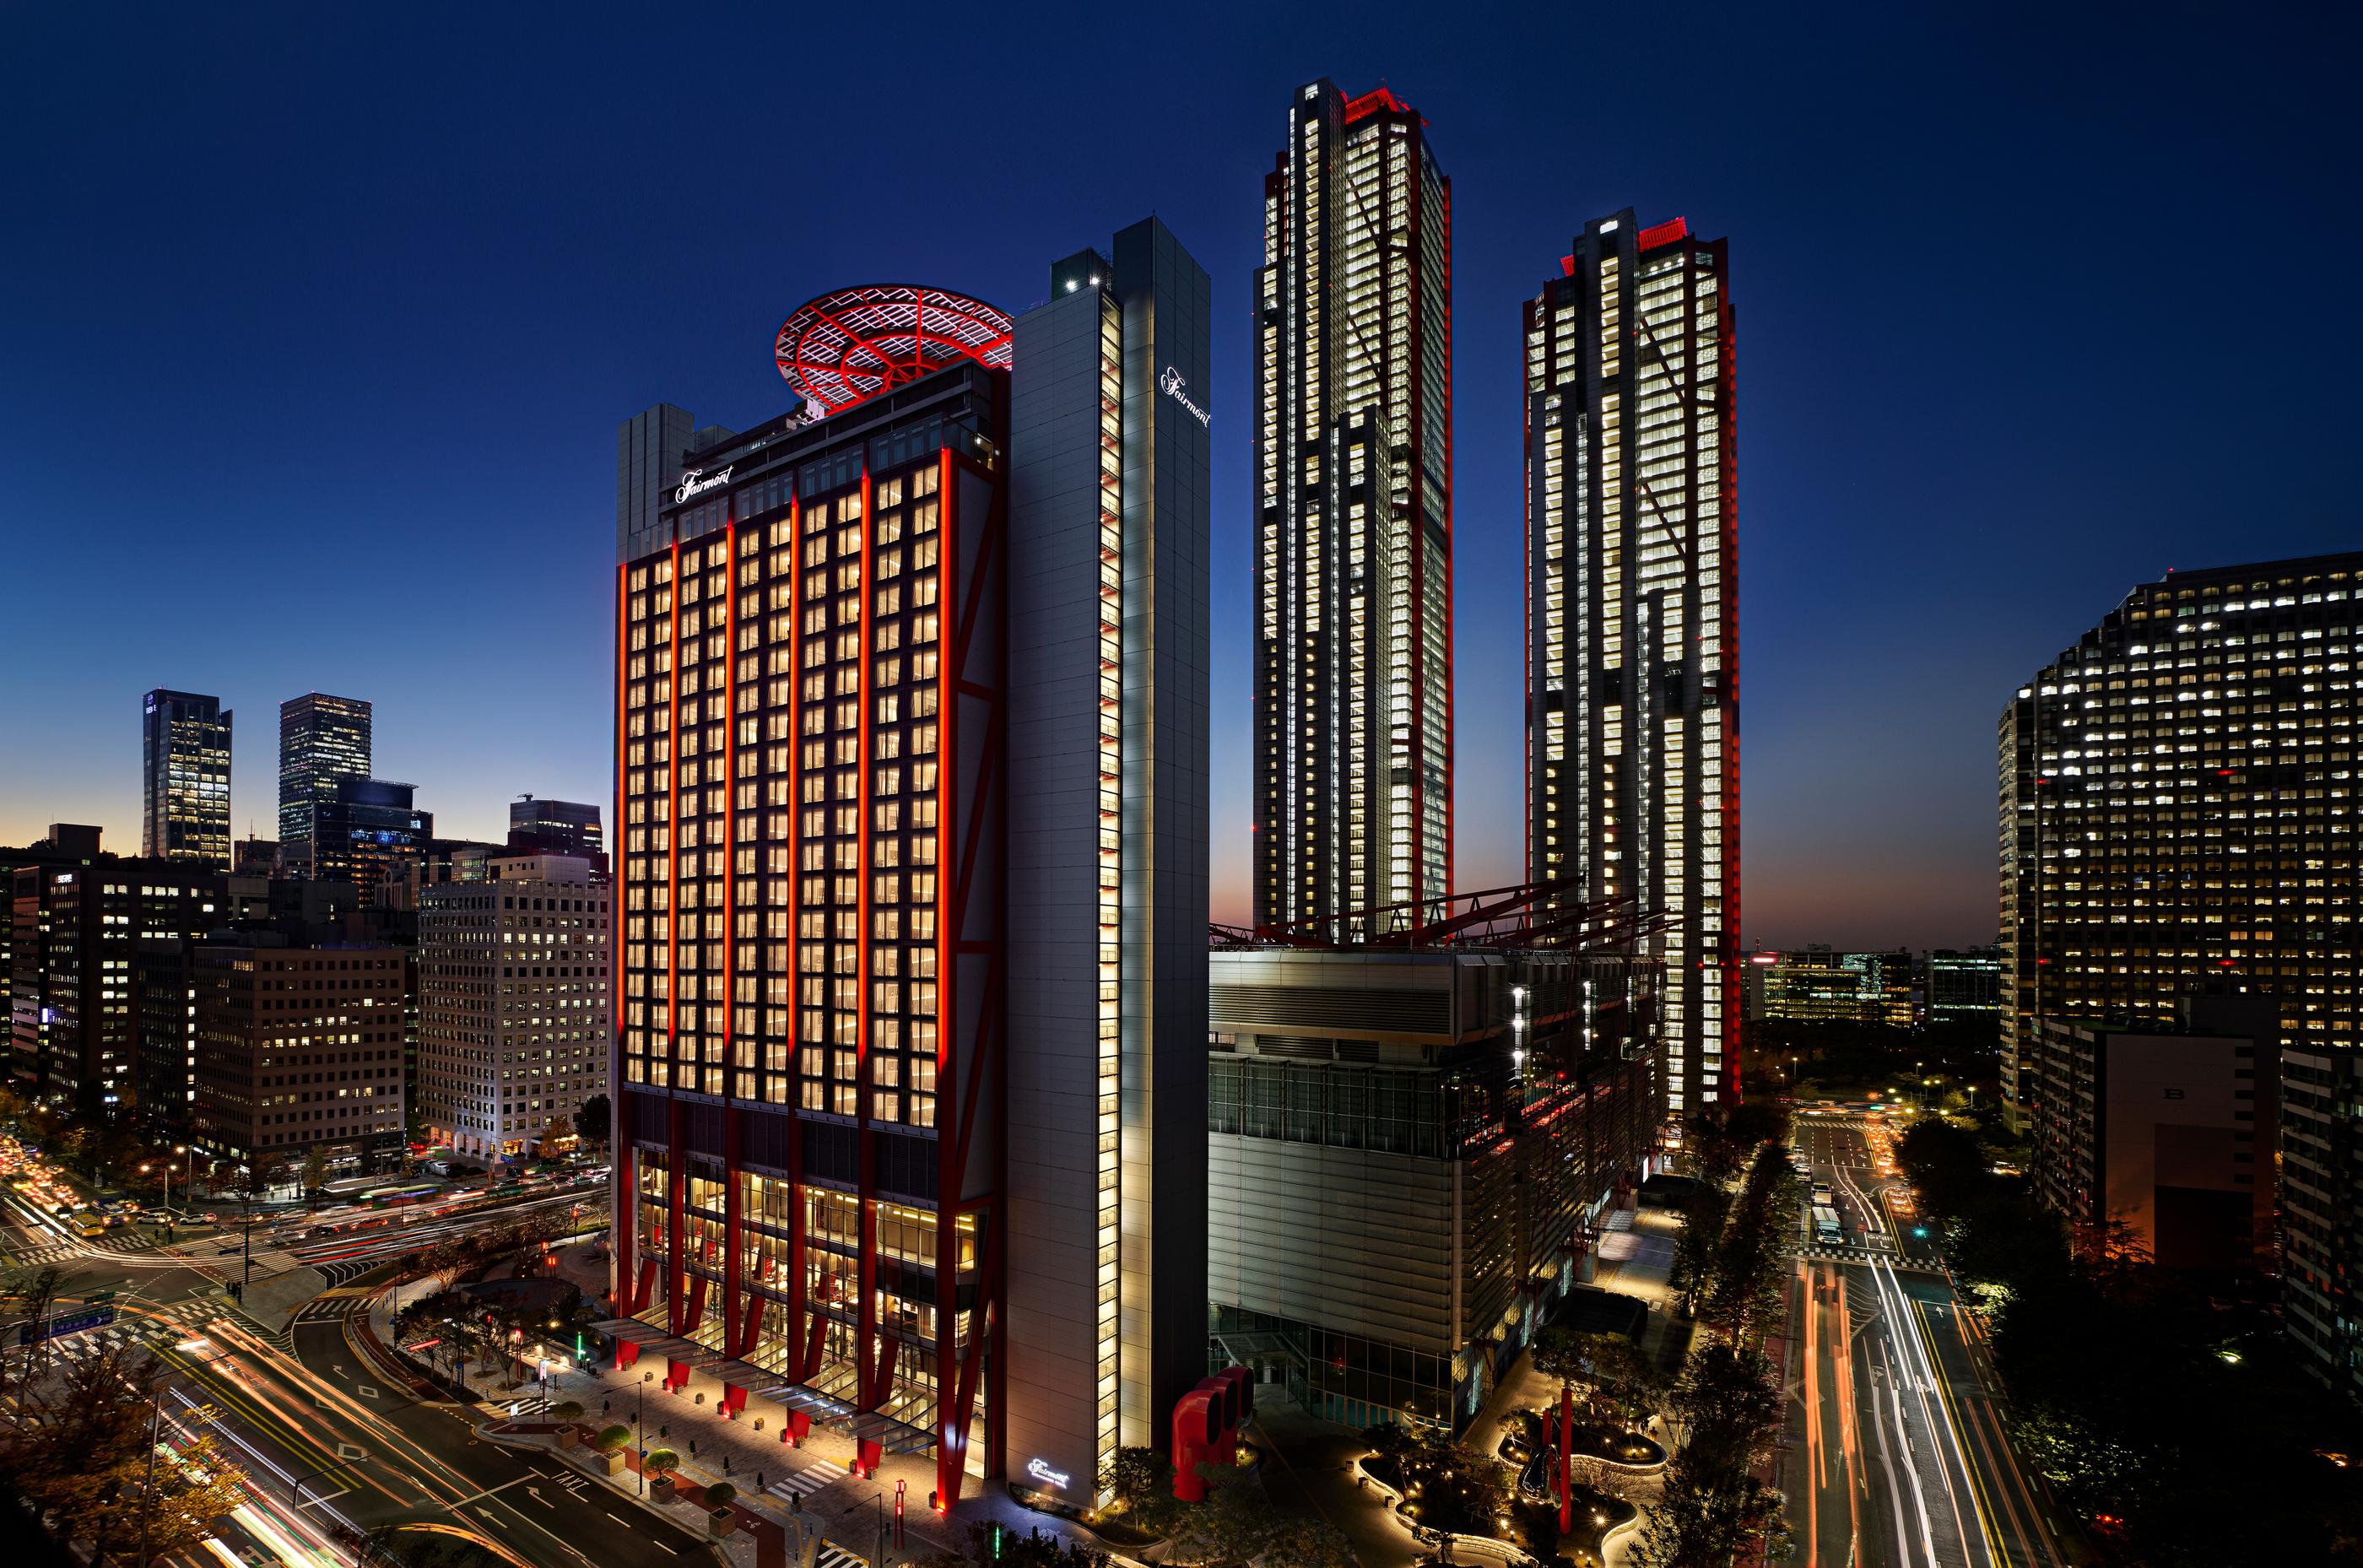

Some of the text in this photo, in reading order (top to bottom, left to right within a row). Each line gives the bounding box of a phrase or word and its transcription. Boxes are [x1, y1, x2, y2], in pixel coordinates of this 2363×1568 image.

[1161, 366, 1212, 428] Fairmont
[676, 465, 734, 504] Fairmont
[550, 1470, 590, 1491] TAXI
[1028, 1458, 1069, 1484] Fairmont
